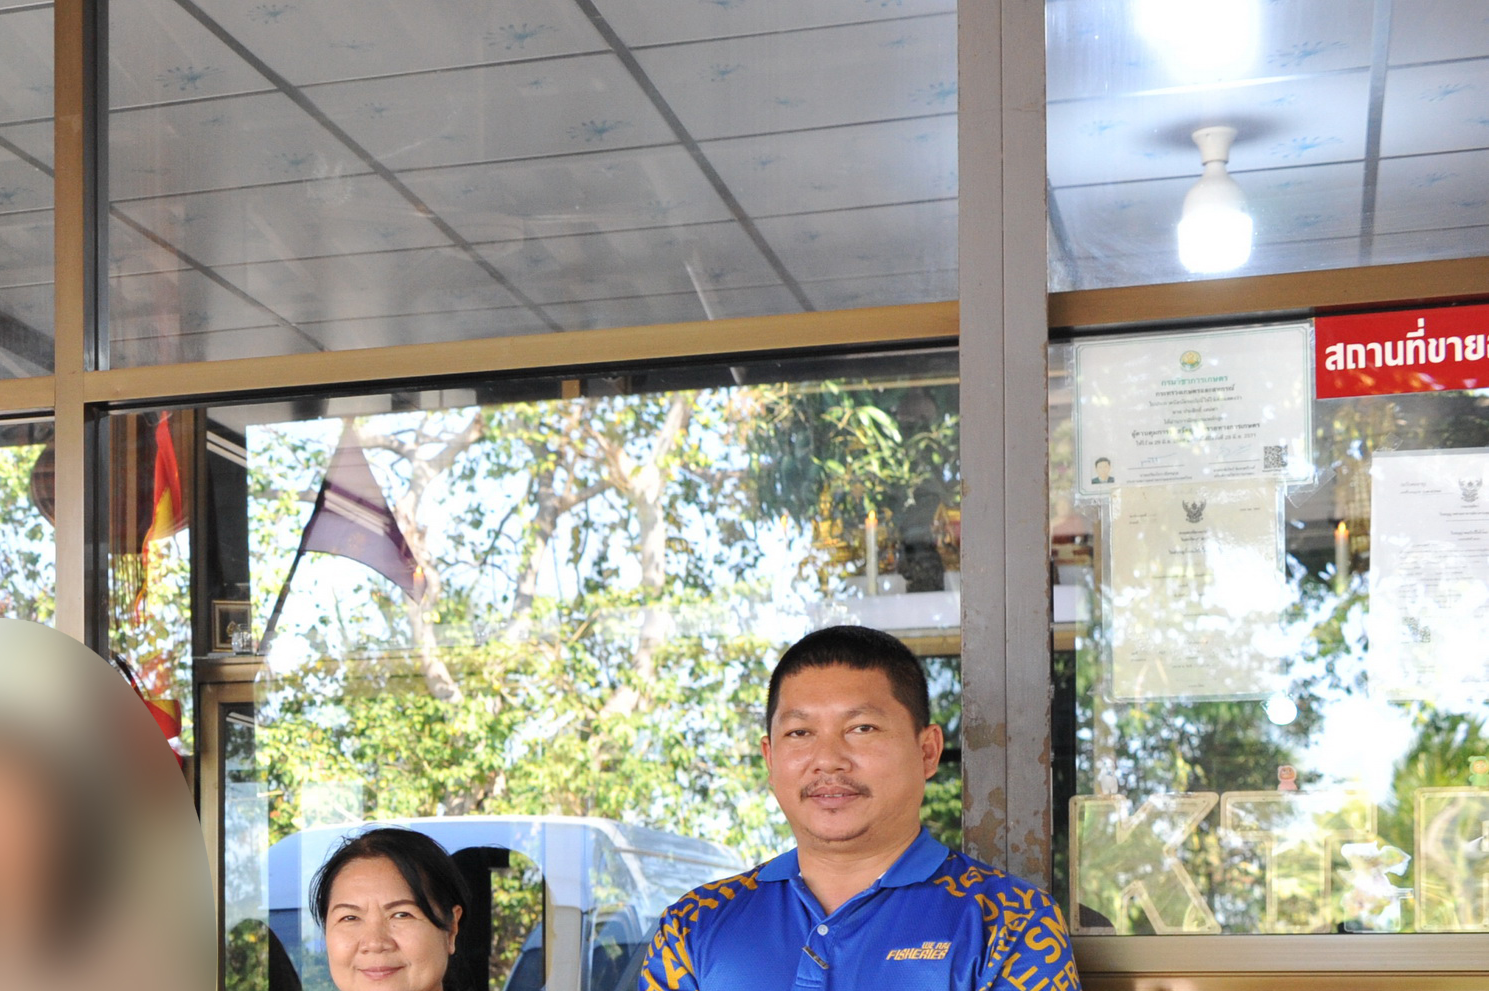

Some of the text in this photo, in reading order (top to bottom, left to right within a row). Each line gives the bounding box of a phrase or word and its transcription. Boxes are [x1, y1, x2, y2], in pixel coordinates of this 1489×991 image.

[1325, 317, 1489, 371] สถานที่ขาย
[886, 948, 949, 961] FISHERIES
